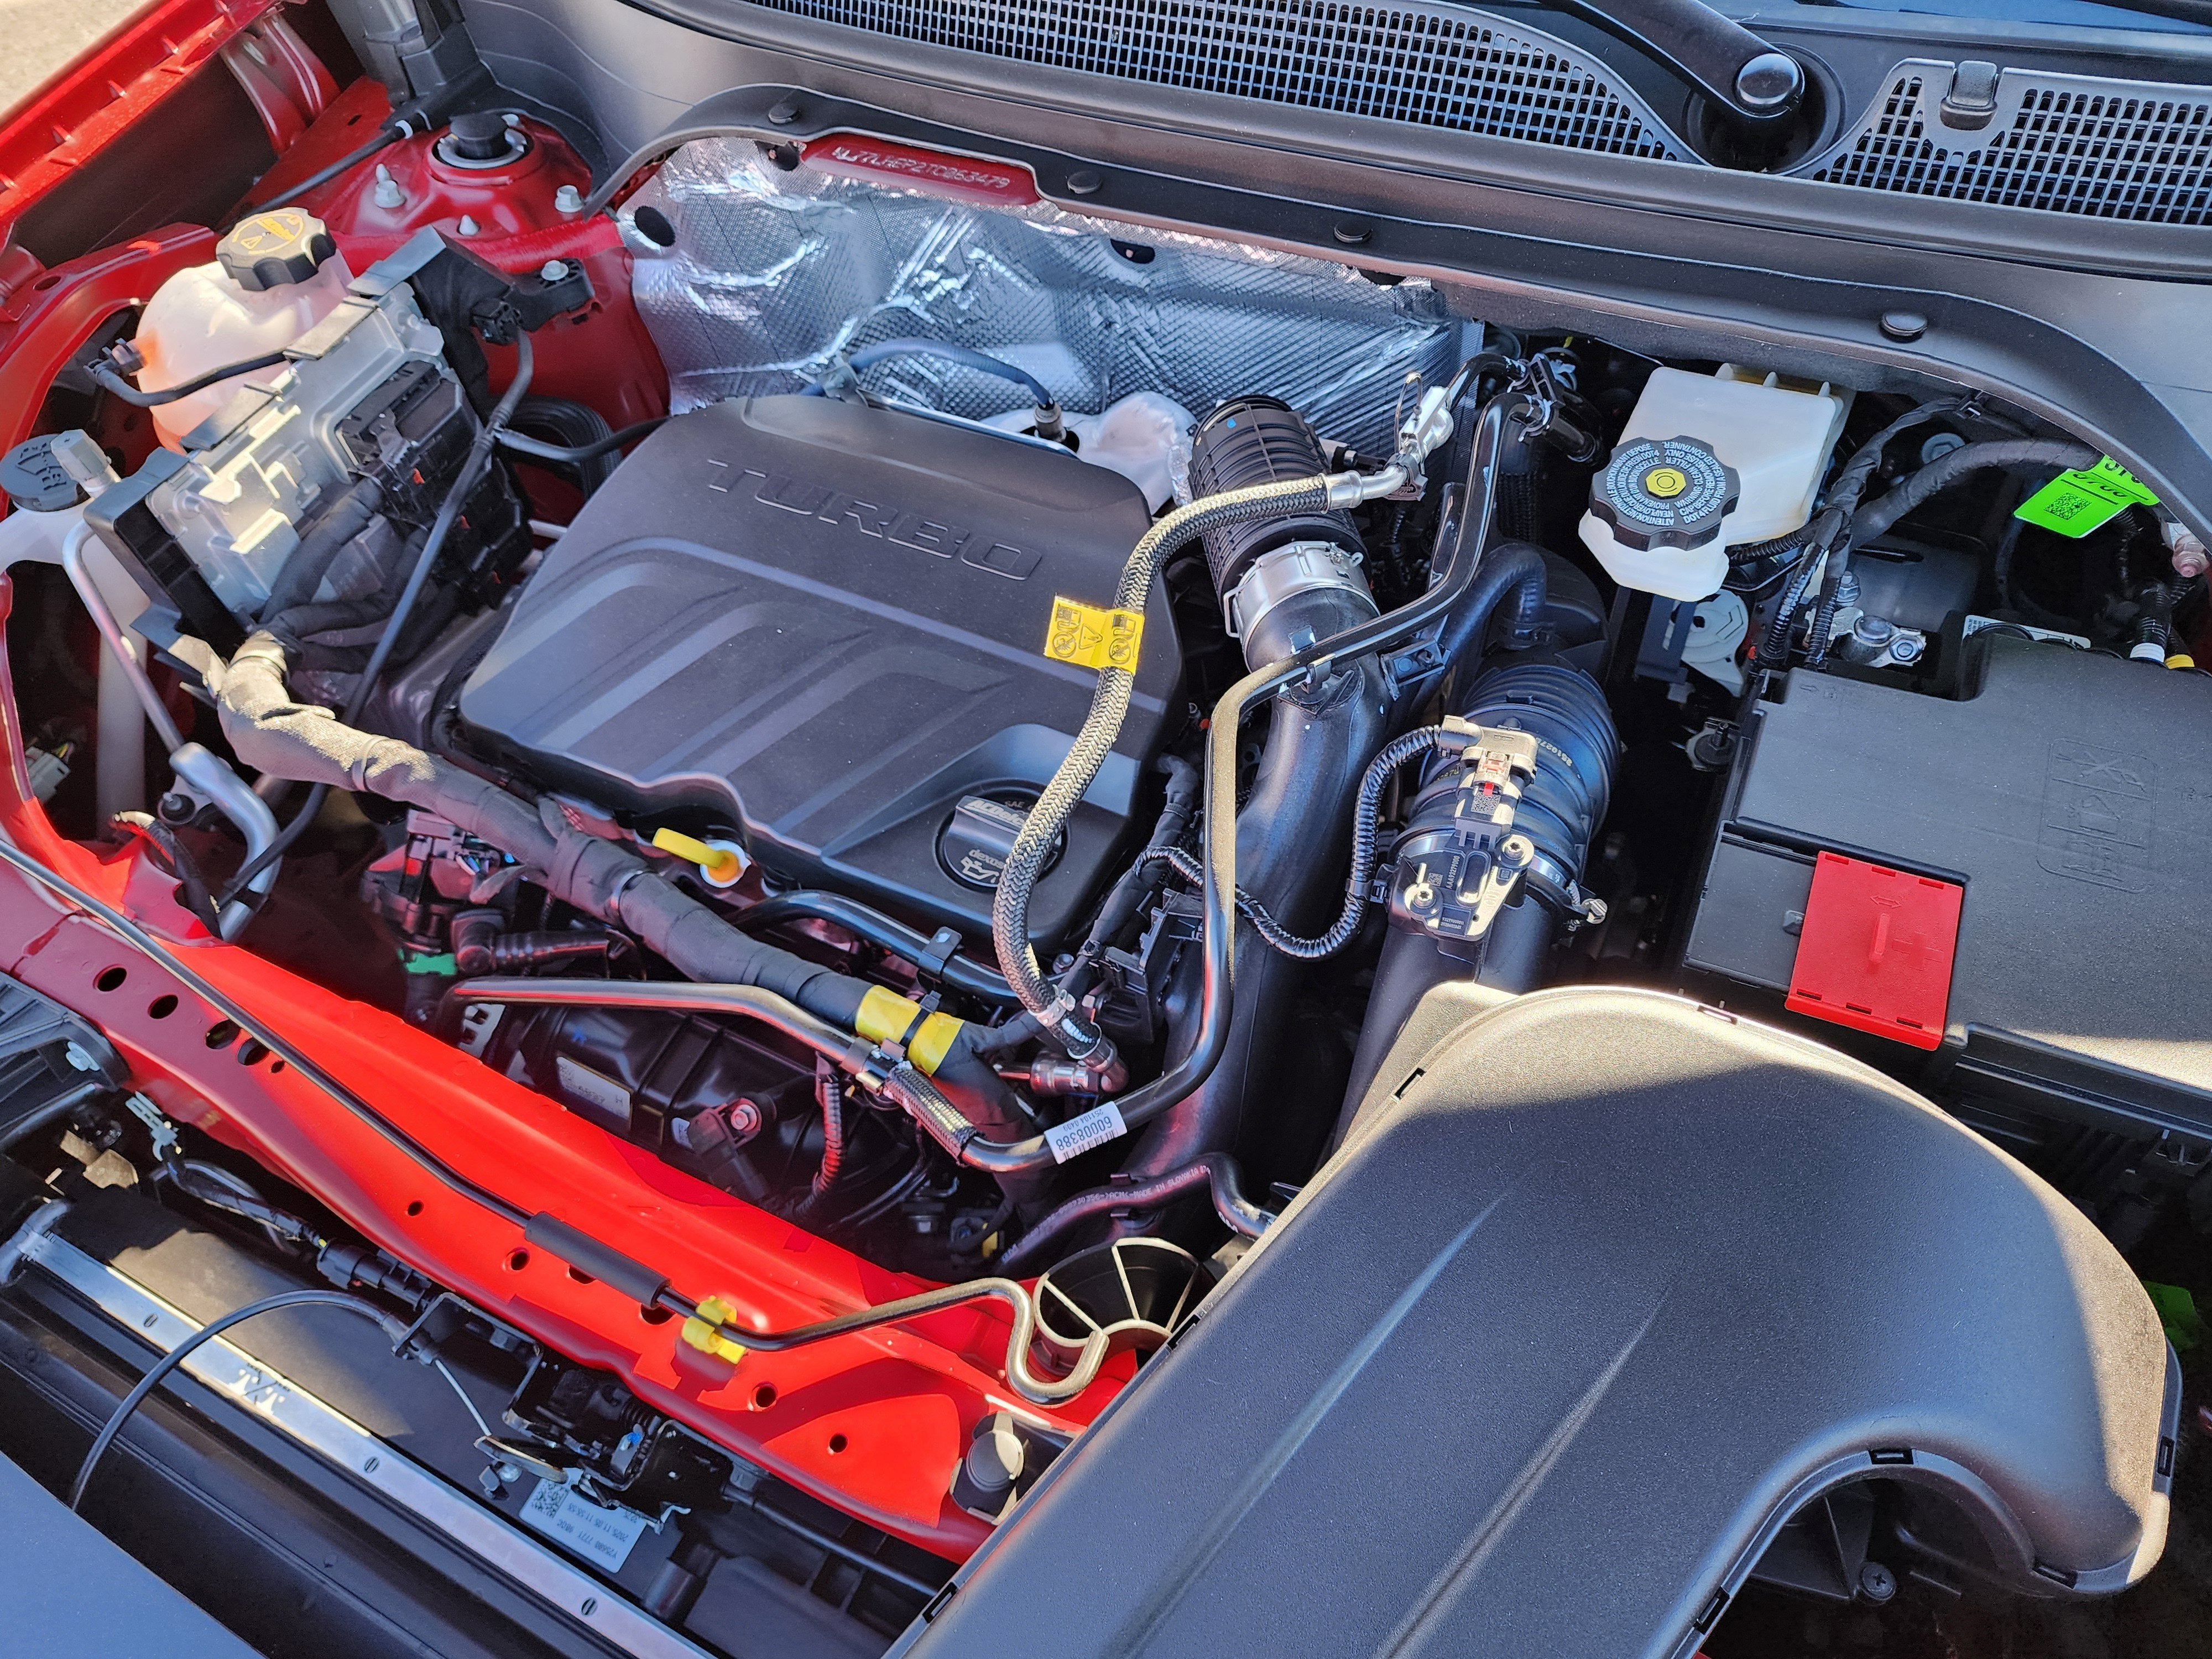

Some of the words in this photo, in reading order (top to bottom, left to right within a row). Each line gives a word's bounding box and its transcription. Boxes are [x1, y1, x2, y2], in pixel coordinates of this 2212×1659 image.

[1611, 453, 1630, 469] AVANT
[1625, 454, 1644, 468] FREIN
[1664, 449, 1685, 458] ONLY
[1683, 453, 1700, 465] USE
[1620, 465, 1632, 474] DE
[1665, 456, 1692, 469] FILLER
[1703, 456, 1725, 477] SEALED
[1606, 467, 1619, 490] BOUCHON
[1616, 472, 1629, 491] LIQUIDE
[1627, 468, 1642, 483] BIDON
[1687, 466, 1704, 485] CLEAN
[1607, 489, 1619, 497] LE
[1618, 489, 1630, 498] DU
[1692, 488, 1715, 509] BEFORE
[1713, 481, 1726, 499] FROM
[1611, 494, 1639, 518] NETTOYER
[1623, 495, 1637, 507] QUE
[1632, 492, 1671, 512] PROVENANT
[1700, 497, 1721, 514] FLUID
[1679, 504, 1694, 516] CAP
[707, 457, 1042, 581] TURBO
[1055, 1116, 1112, 1151] 60008388
[1166, 1168, 1199, 1188] SLOVAKIA
